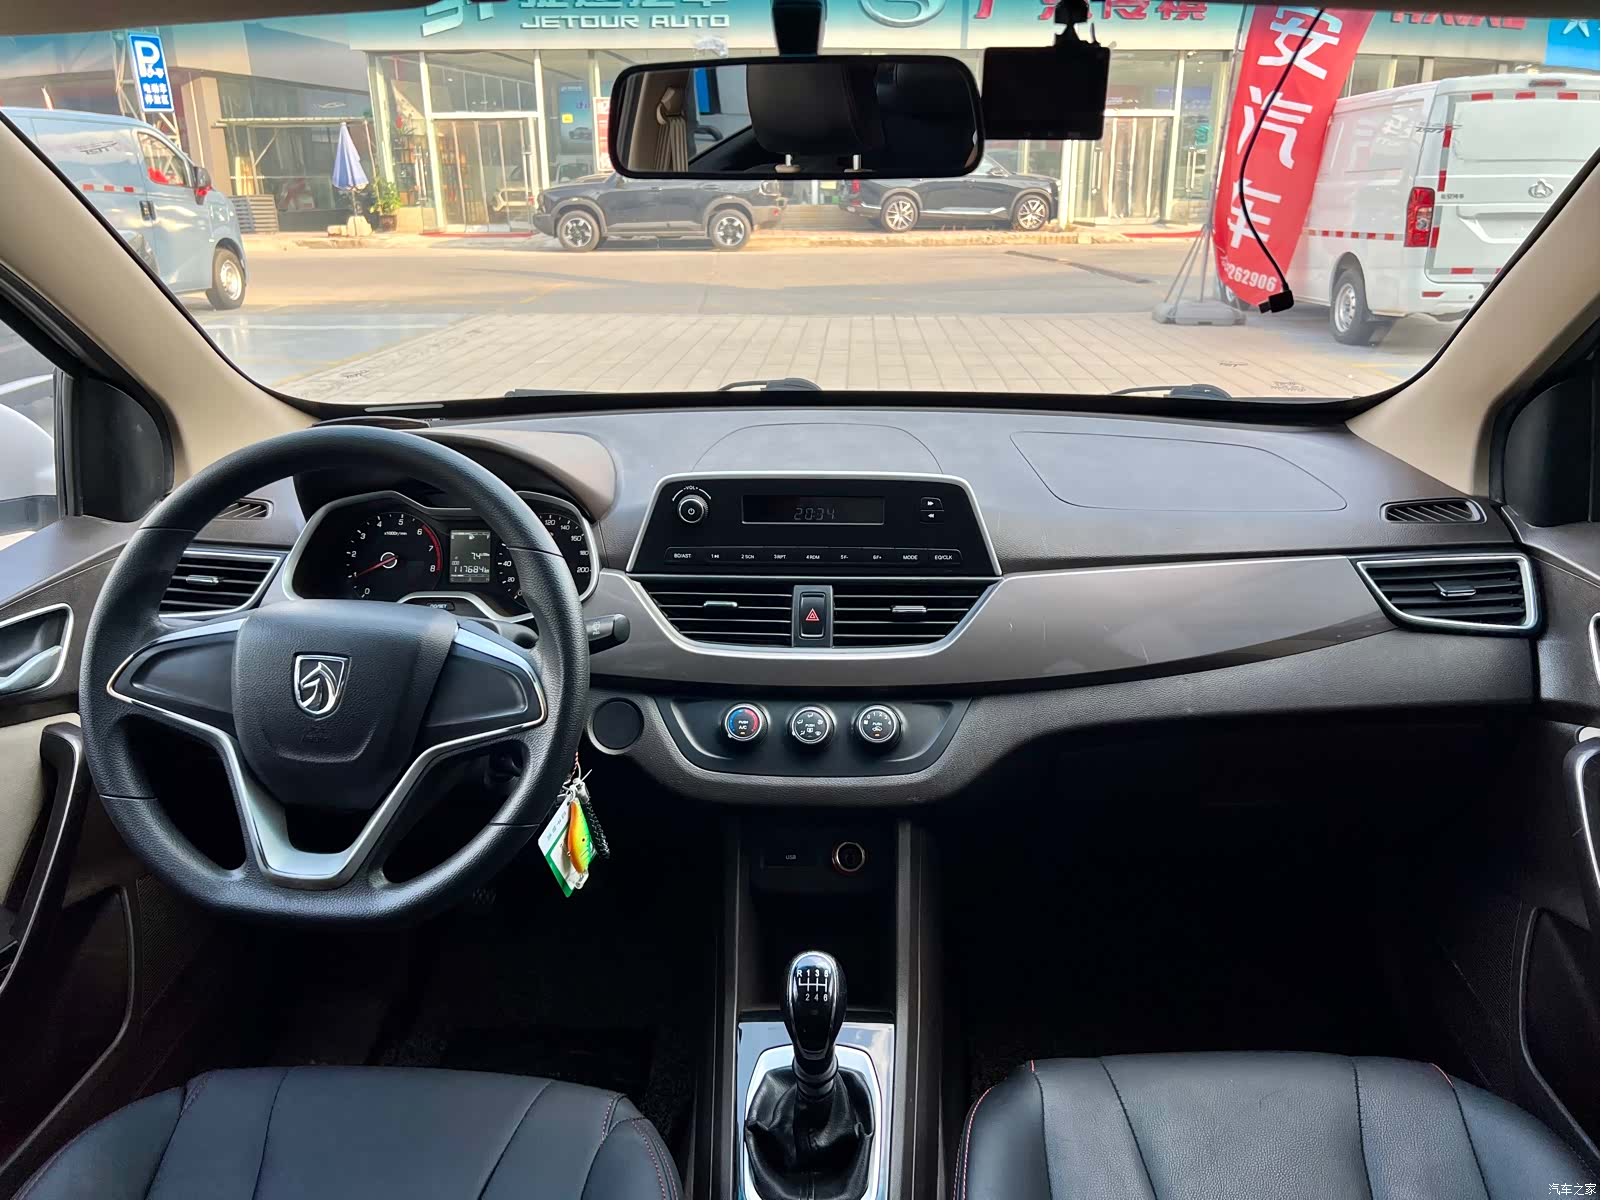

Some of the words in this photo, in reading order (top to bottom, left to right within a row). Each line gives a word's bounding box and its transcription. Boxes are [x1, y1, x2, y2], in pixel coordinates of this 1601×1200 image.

[521, 15, 640, 28] JETOUR
[650, 15, 730, 28] AUTO
[134, 40, 161, 77] P
[576, 566, 590, 574] 200
[796, 969, 803, 978] R
[806, 969, 810, 977] 1
[815, 969, 820, 977] 3
[824, 969, 829, 978] 5
[805, 993, 810, 1001] 2
[814, 993, 819, 1001] 4
[823, 993, 828, 1002] 6
